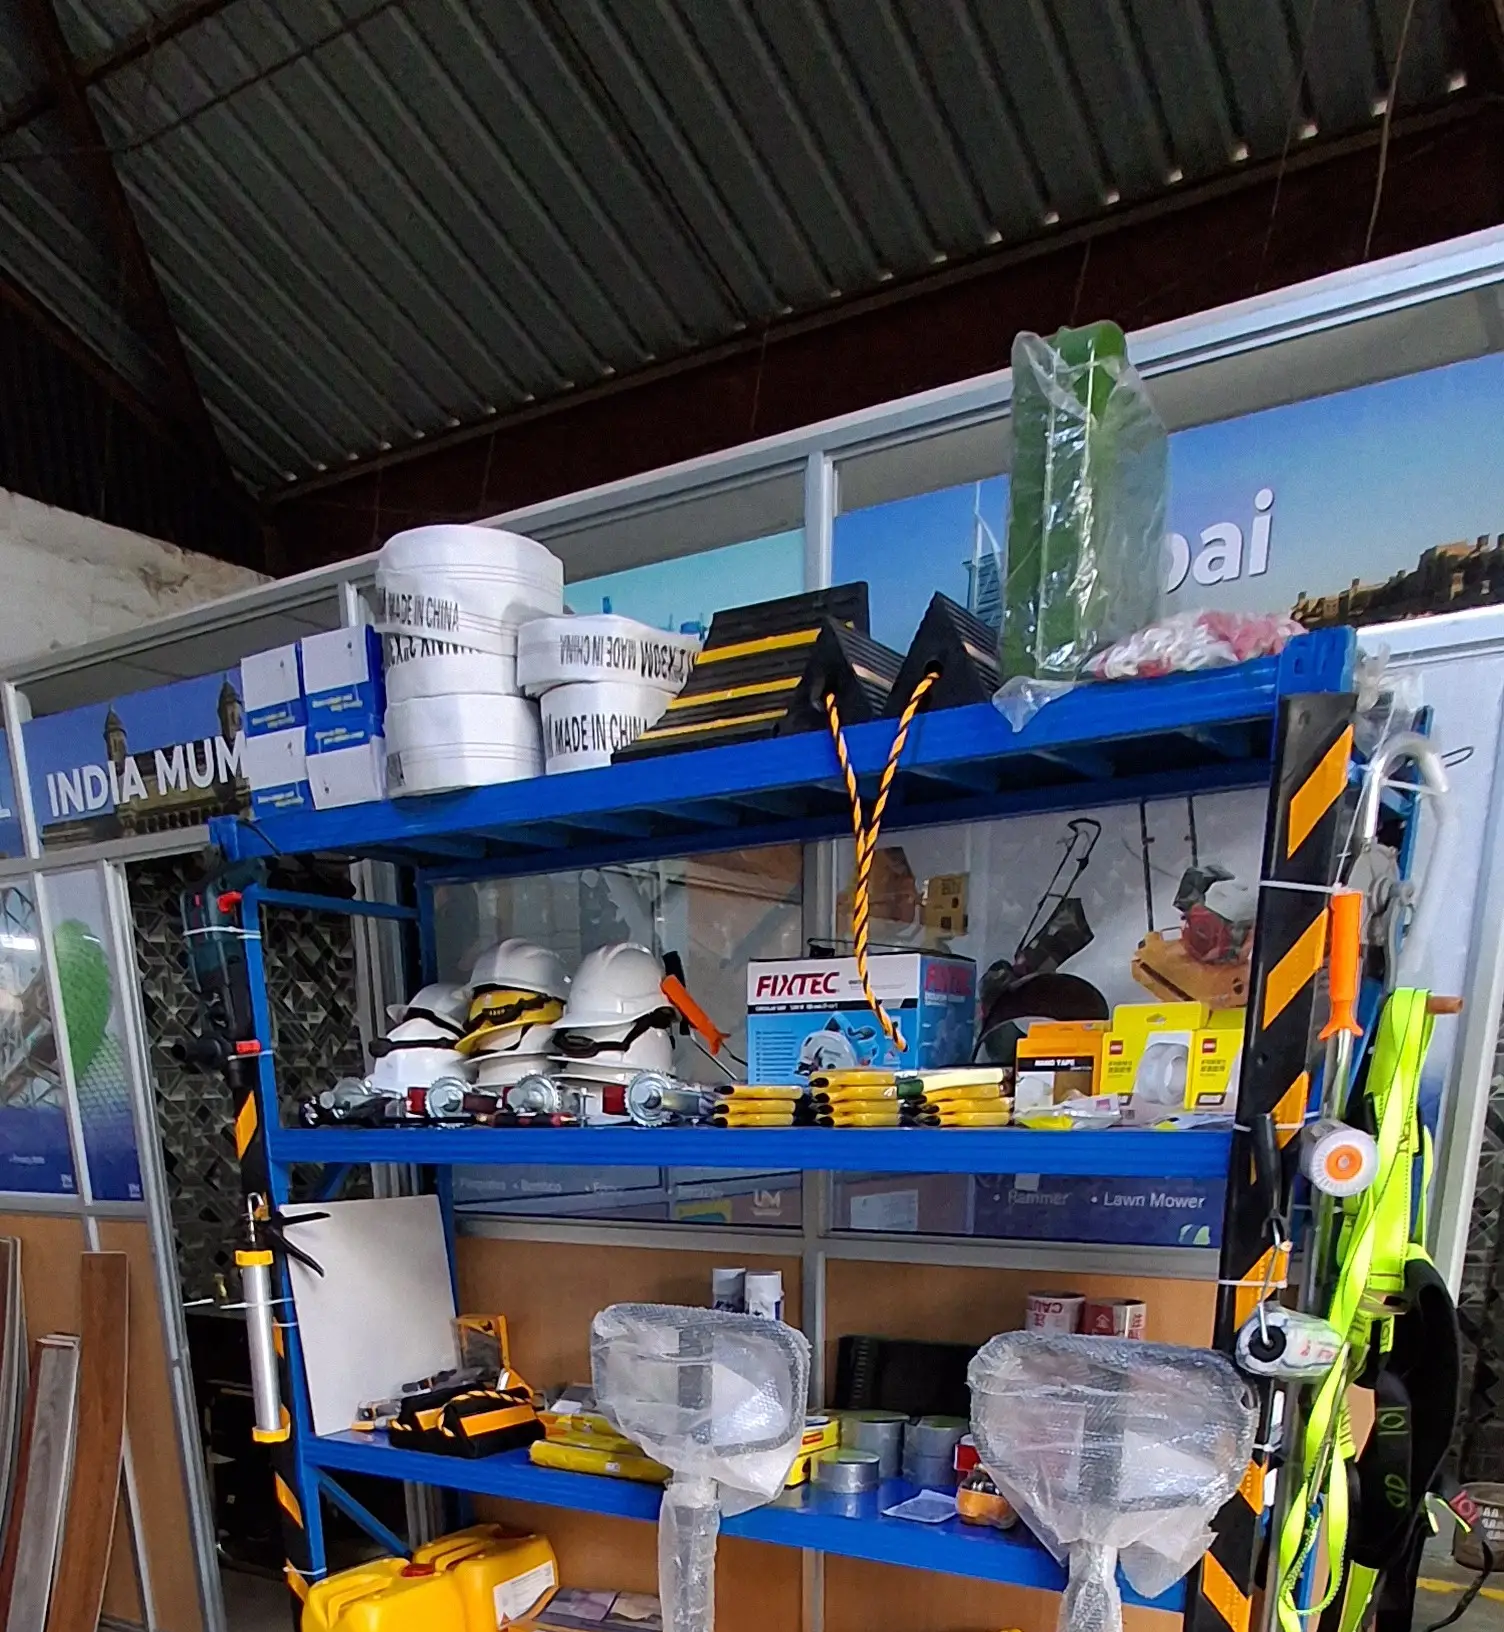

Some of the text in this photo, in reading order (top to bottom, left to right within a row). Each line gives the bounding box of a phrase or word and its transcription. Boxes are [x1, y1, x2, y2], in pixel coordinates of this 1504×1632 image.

[414, 595, 424, 627] IN
[426, 597, 460, 632] CHINA
[559, 634, 590, 666] CHINA
[593, 634, 605, 667] IN
[606, 636, 637, 671] MADE
[554, 714, 588, 754] MADE
[591, 713, 607, 751] IN
[46, 757, 148, 817] INDIA
[755, 971, 841, 998] FIXTEC
[1103, 1191, 1206, 1209] Lawn Mower
